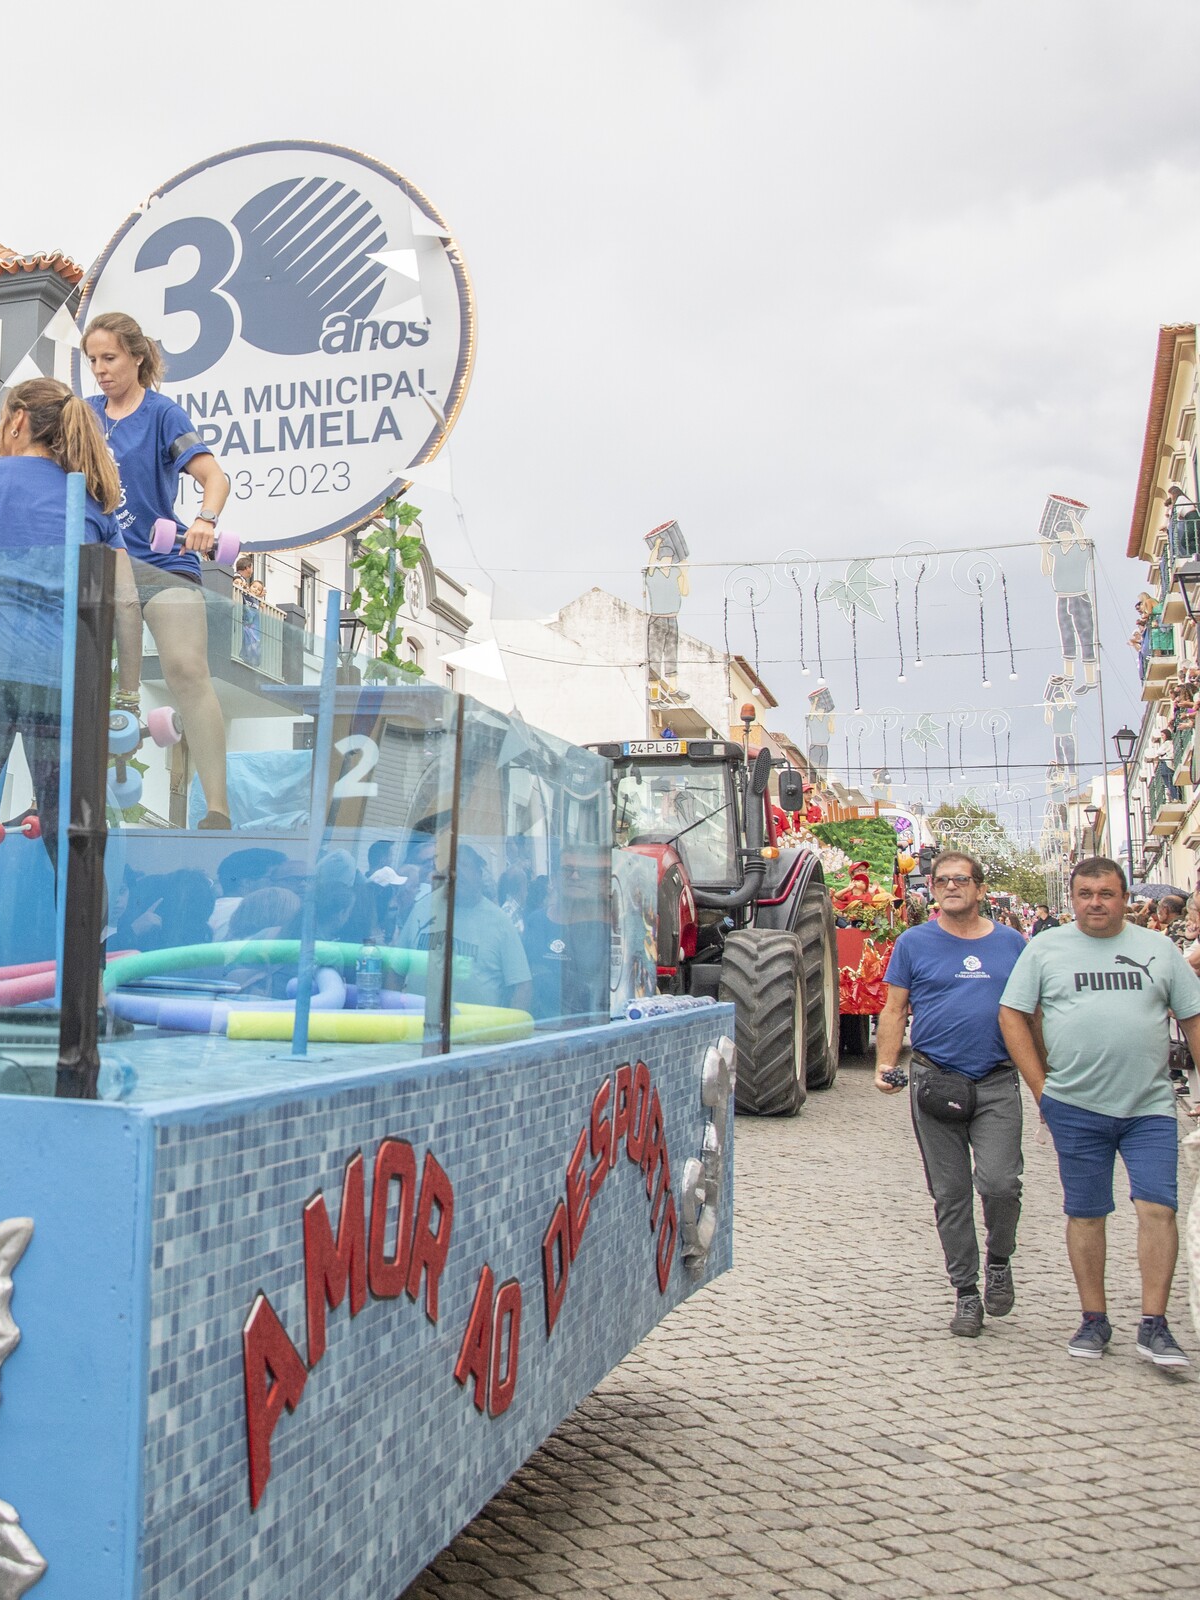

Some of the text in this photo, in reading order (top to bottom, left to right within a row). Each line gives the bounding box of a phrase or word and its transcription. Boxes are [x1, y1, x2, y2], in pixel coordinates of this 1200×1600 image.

[320, 312, 431, 355] anos
[244, 369, 437, 414] MUNICIPAL
[197, 406, 403, 457] PALMELA
[178, 461, 350, 505] 193-2023
[333, 734, 380, 798] 2
[1074, 971, 1143, 992] PUMA
[243, 1059, 677, 1513] AMOR AO DESPORTO
